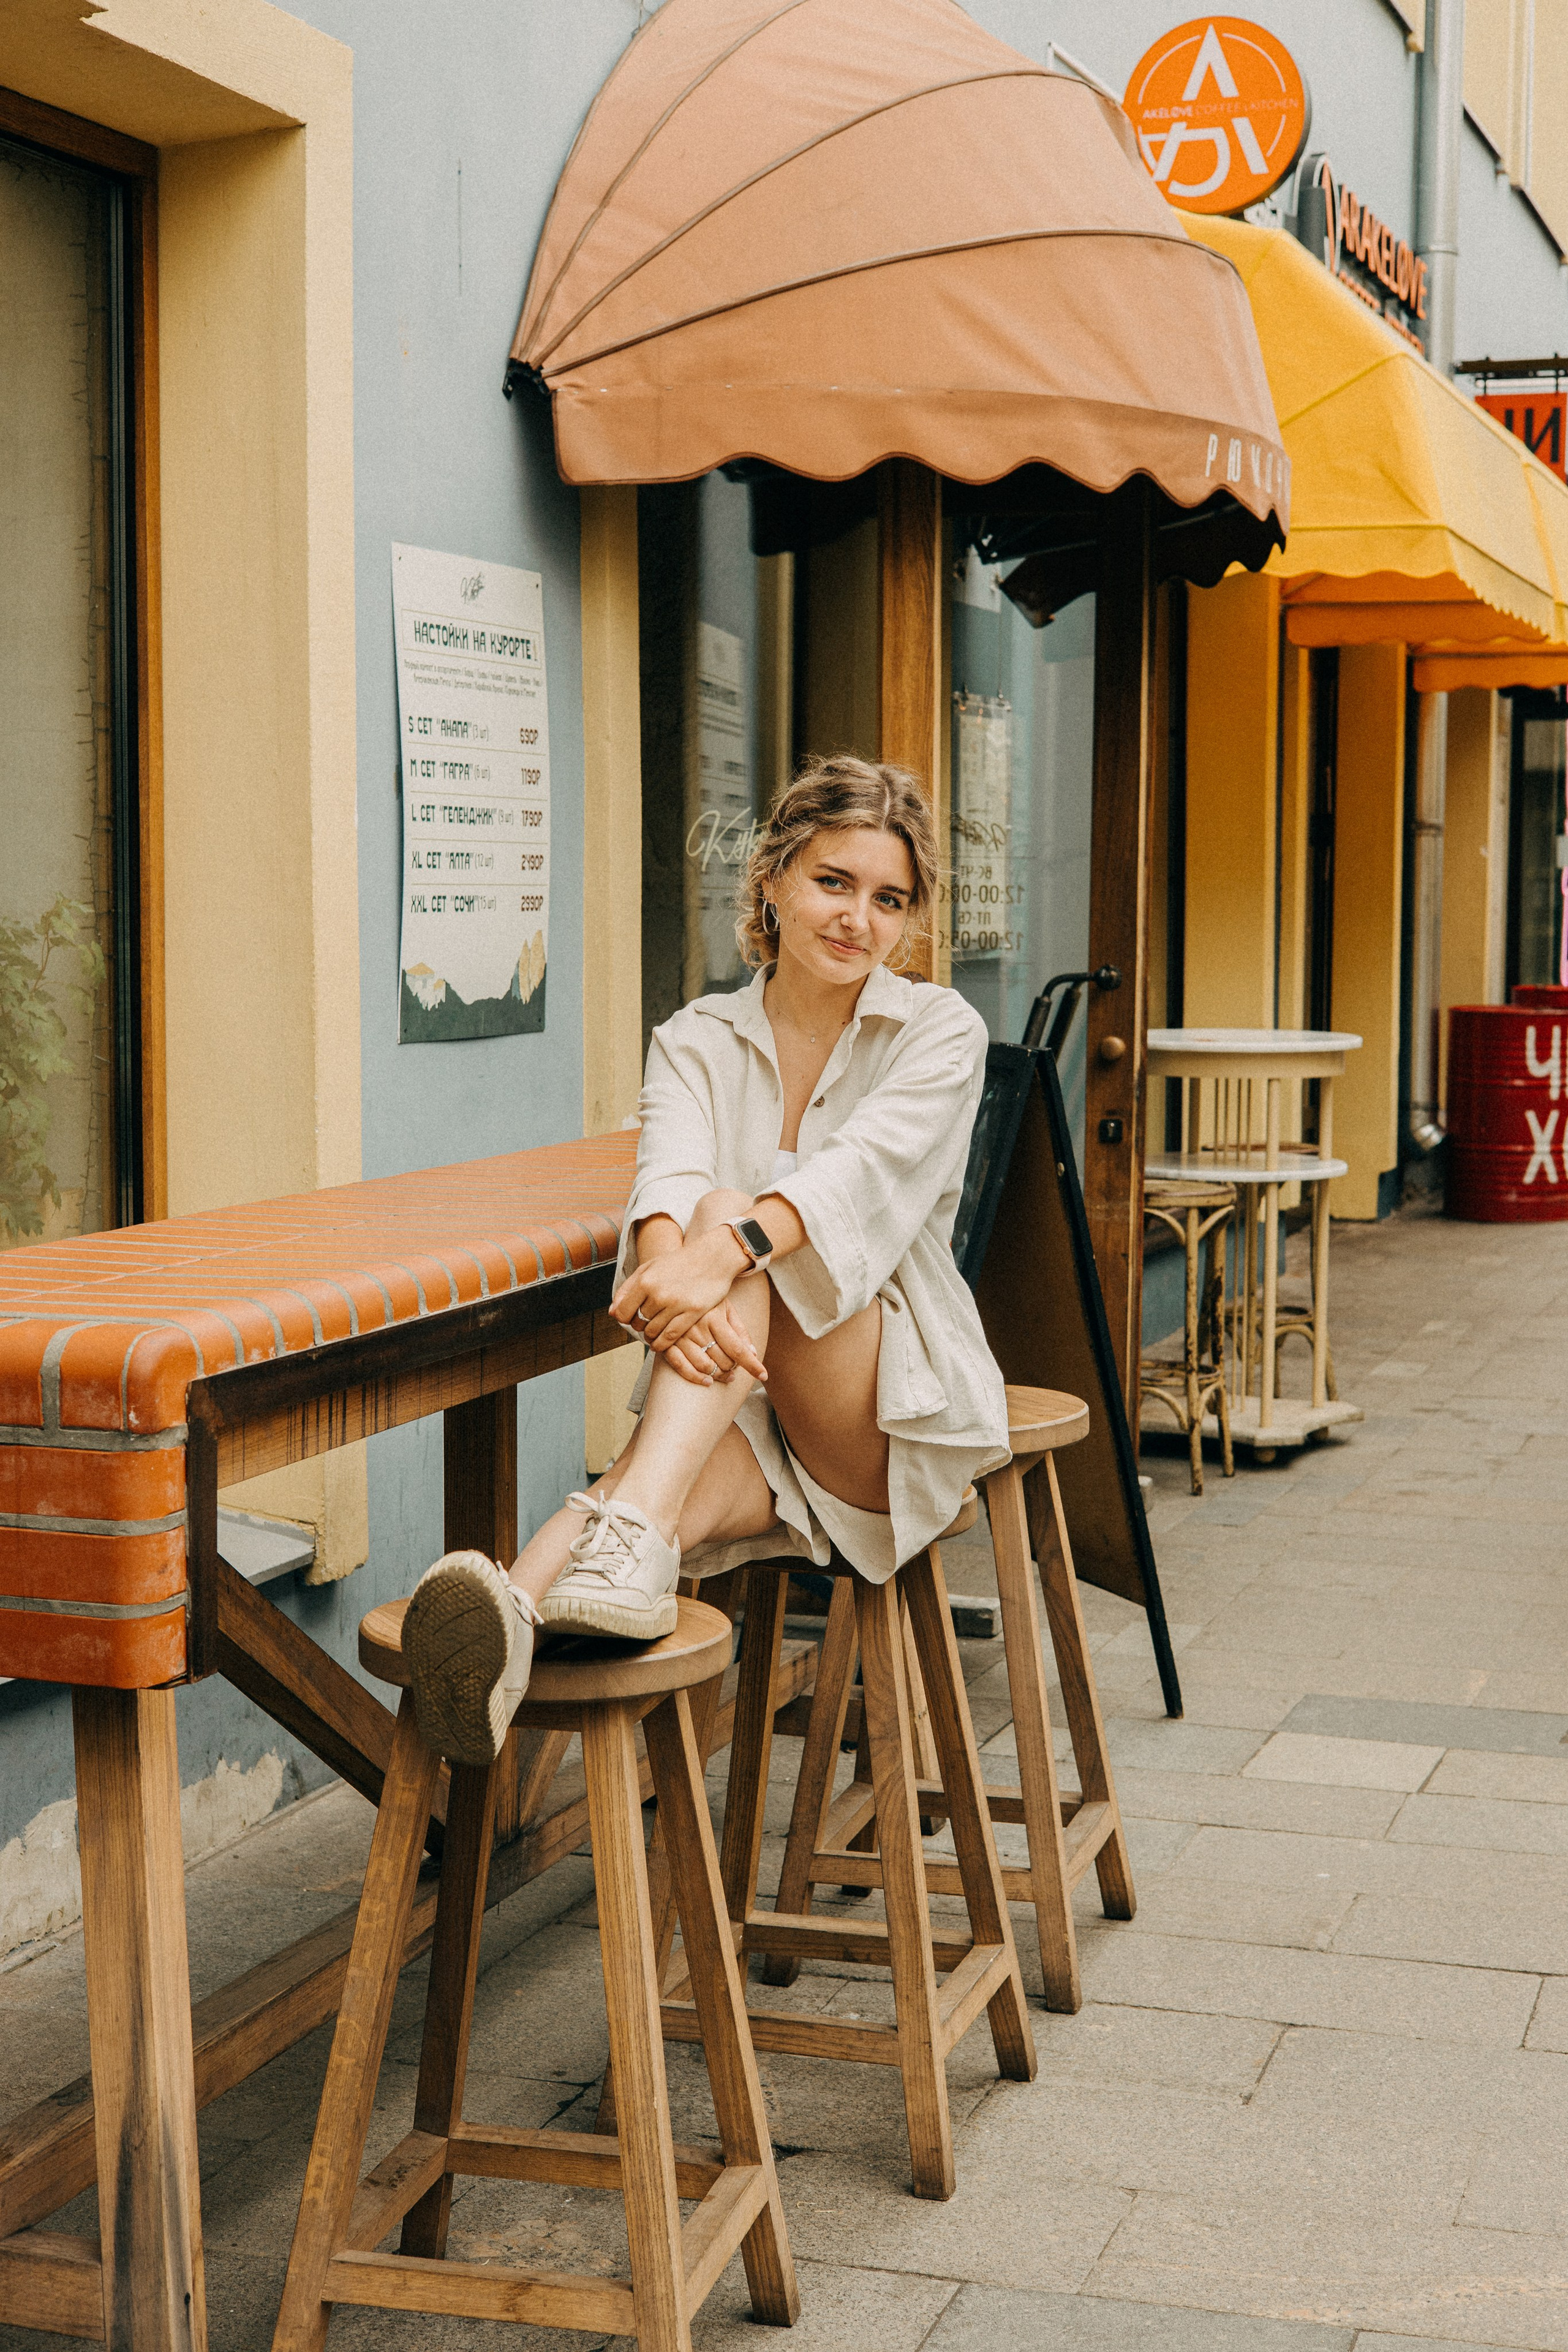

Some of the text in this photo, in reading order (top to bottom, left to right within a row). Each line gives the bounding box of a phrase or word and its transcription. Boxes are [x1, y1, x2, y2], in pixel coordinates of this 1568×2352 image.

[413, 620, 532, 660] НАСТОЙКИ НА КУРОРТЕ
[418, 717, 432, 735] СЕТ
[421, 760, 435, 778] СЕТ
[421, 805, 435, 822] СЕТ
[426, 851, 442, 869] СЕТ
[431, 895, 447, 913] СЕТ
